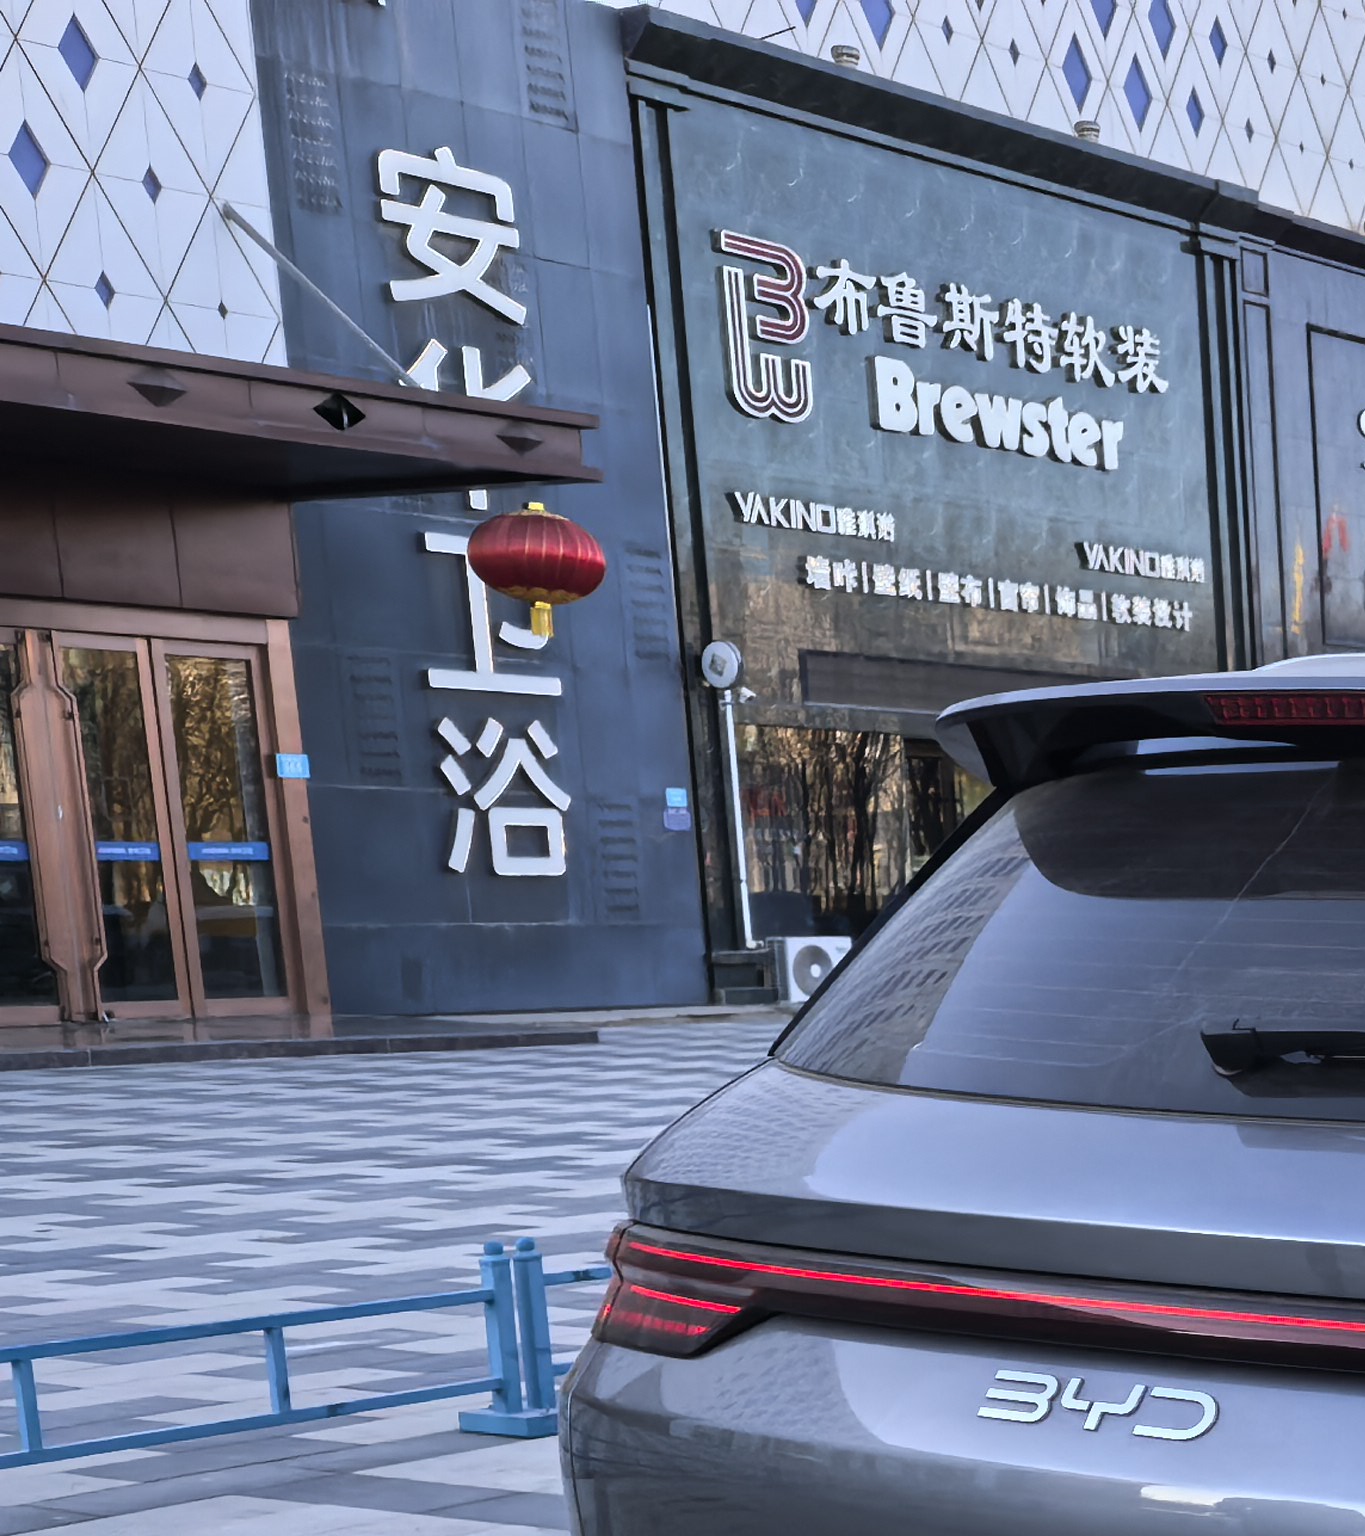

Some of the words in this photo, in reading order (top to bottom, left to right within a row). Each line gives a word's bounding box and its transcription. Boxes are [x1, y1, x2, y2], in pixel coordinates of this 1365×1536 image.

[814, 259, 1169, 393] 布鲁斯特软装
[874, 355, 1124, 471] Brewster
[976, 1369, 1219, 1441] BYD
